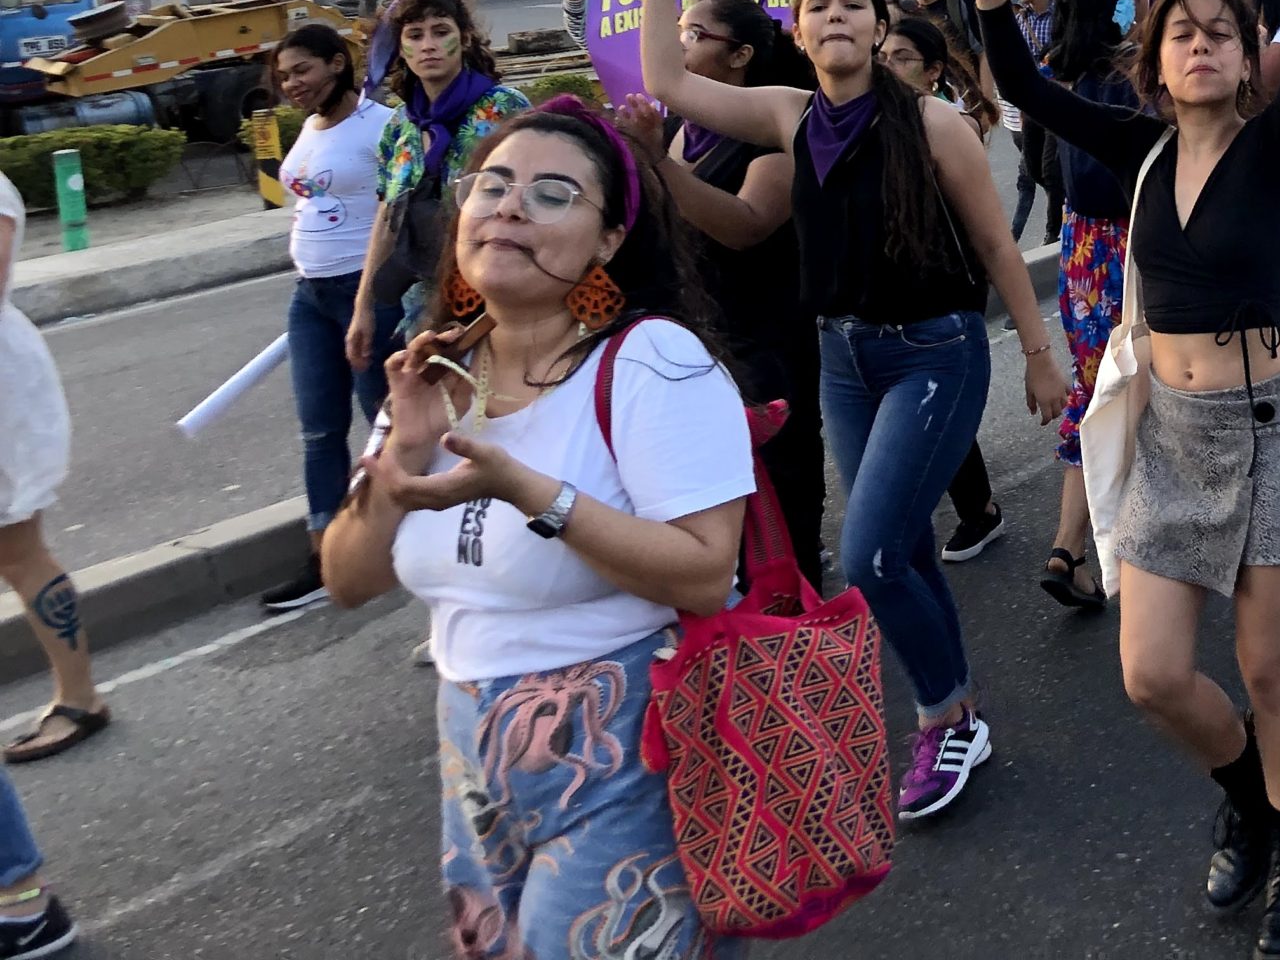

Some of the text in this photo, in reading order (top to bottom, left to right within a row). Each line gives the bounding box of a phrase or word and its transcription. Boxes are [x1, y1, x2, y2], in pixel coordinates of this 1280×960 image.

[600, 16, 613, 38] A
[461, 507, 486, 537] ES
[458, 534, 483, 567] NO
